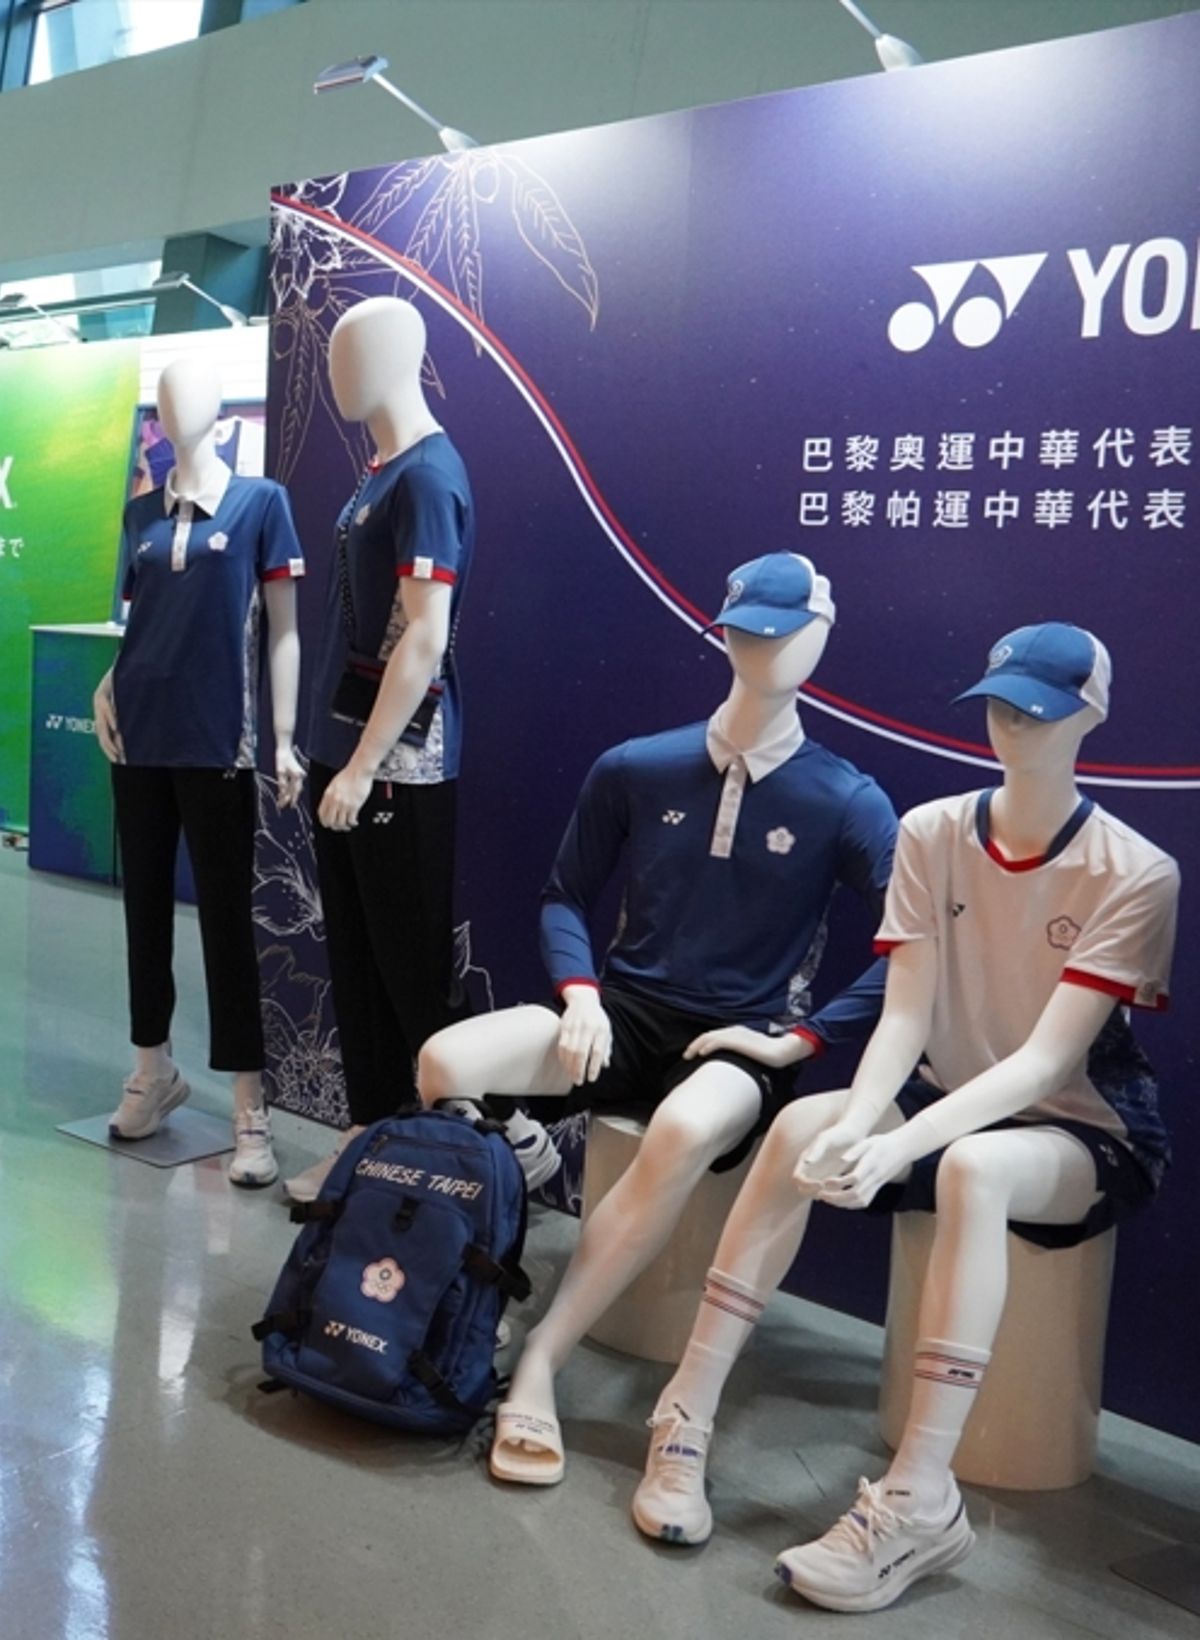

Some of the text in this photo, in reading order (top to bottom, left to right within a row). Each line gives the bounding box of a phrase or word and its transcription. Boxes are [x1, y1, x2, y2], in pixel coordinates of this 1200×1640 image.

[1066, 237, 1200, 338] YO
[803, 425, 1193, 473] 巴黎奧運中華代表
[799, 488, 1187, 530] 巴黎帕運中華代表
[355, 1157, 485, 1201] CHINESE TAIPEI
[345, 1326, 389, 1355] YONEX
